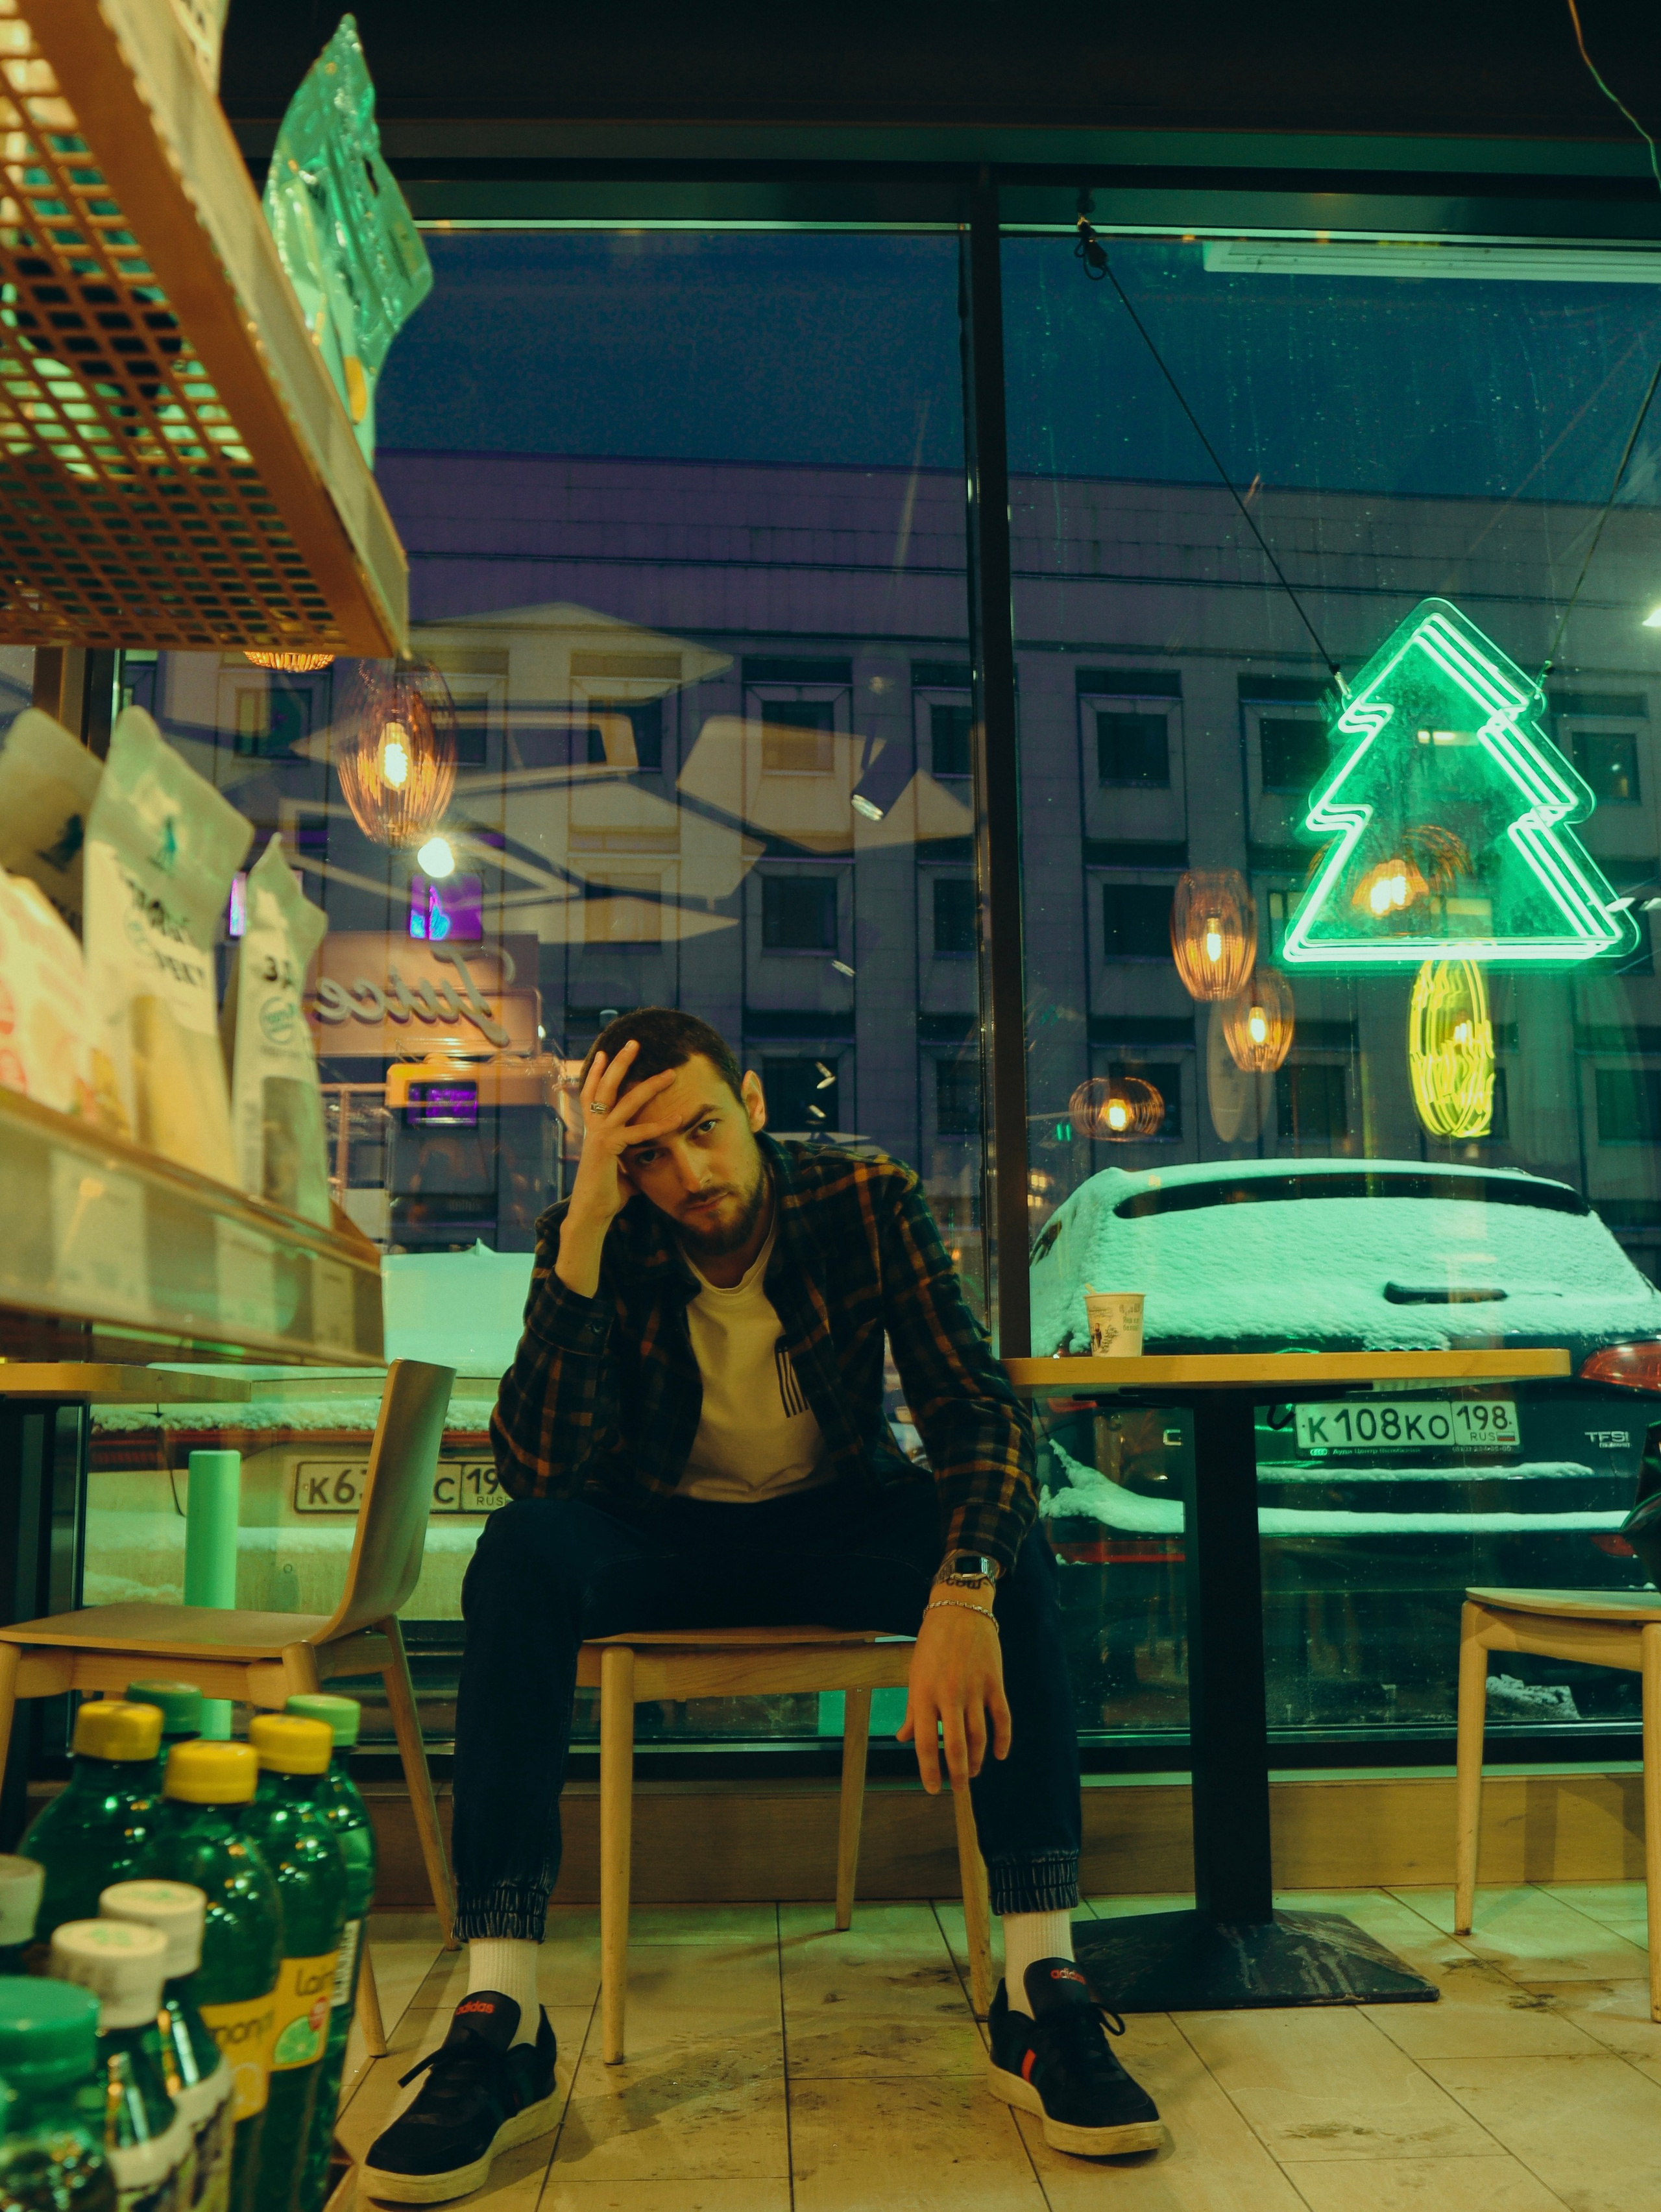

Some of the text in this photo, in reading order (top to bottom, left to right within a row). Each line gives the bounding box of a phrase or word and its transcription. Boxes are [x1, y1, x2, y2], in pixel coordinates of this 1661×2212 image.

[1456, 1404, 1508, 1431] 198
[1470, 1432, 1496, 1441] RUS
[1584, 1431, 1629, 1443] TFSI
[476, 1496, 505, 1506] RUS
[455, 2001, 495, 2015] adidas
